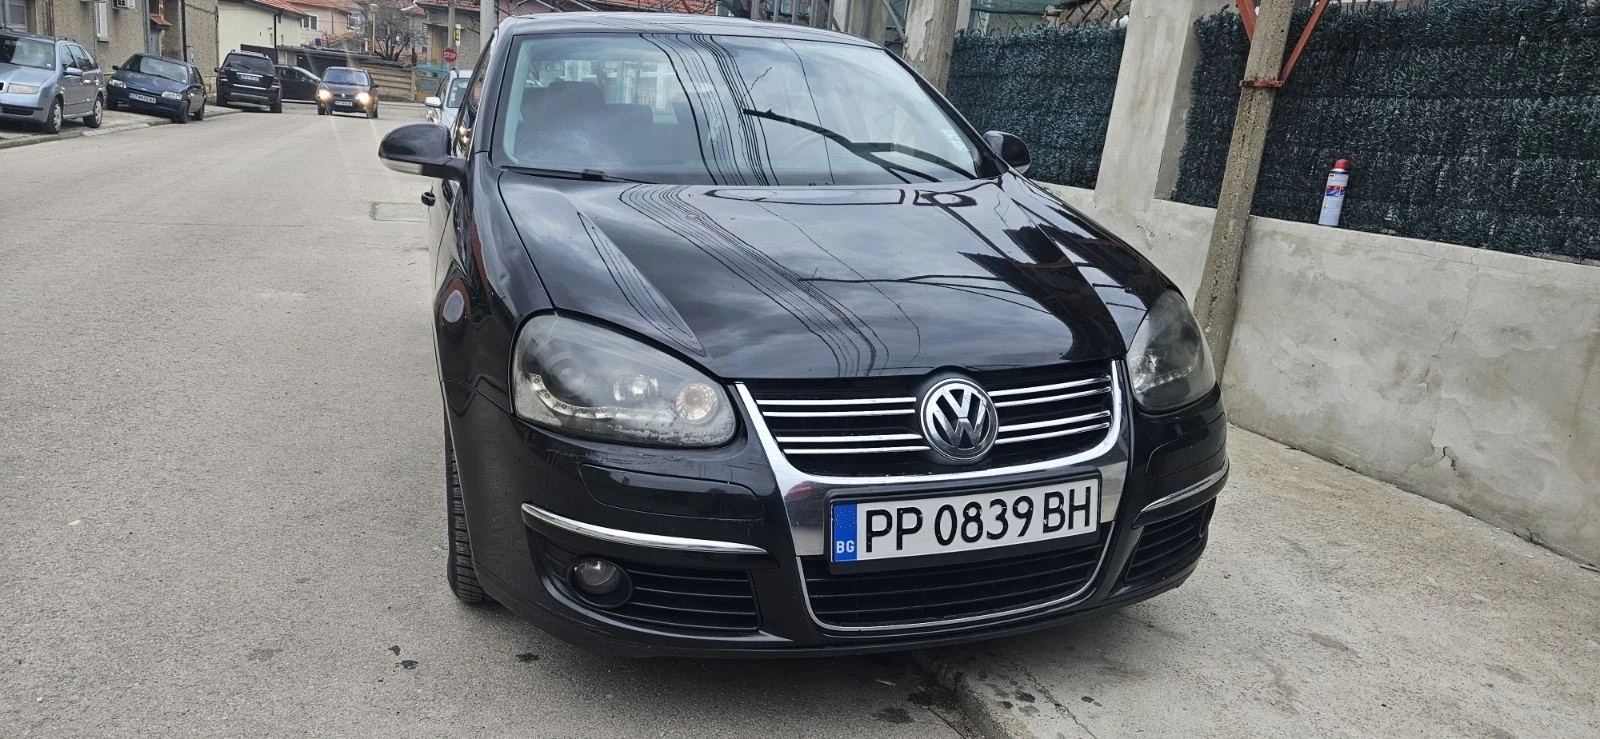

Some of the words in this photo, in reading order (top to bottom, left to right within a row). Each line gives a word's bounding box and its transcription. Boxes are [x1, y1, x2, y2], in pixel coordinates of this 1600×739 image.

[443, 51, 457, 59] STOP
[925, 382, 993, 456] VW
[865, 506, 923, 553] PP
[934, 495, 1034, 546] 0839
[1042, 486, 1092, 533] BH
[835, 540, 855, 554] BG
